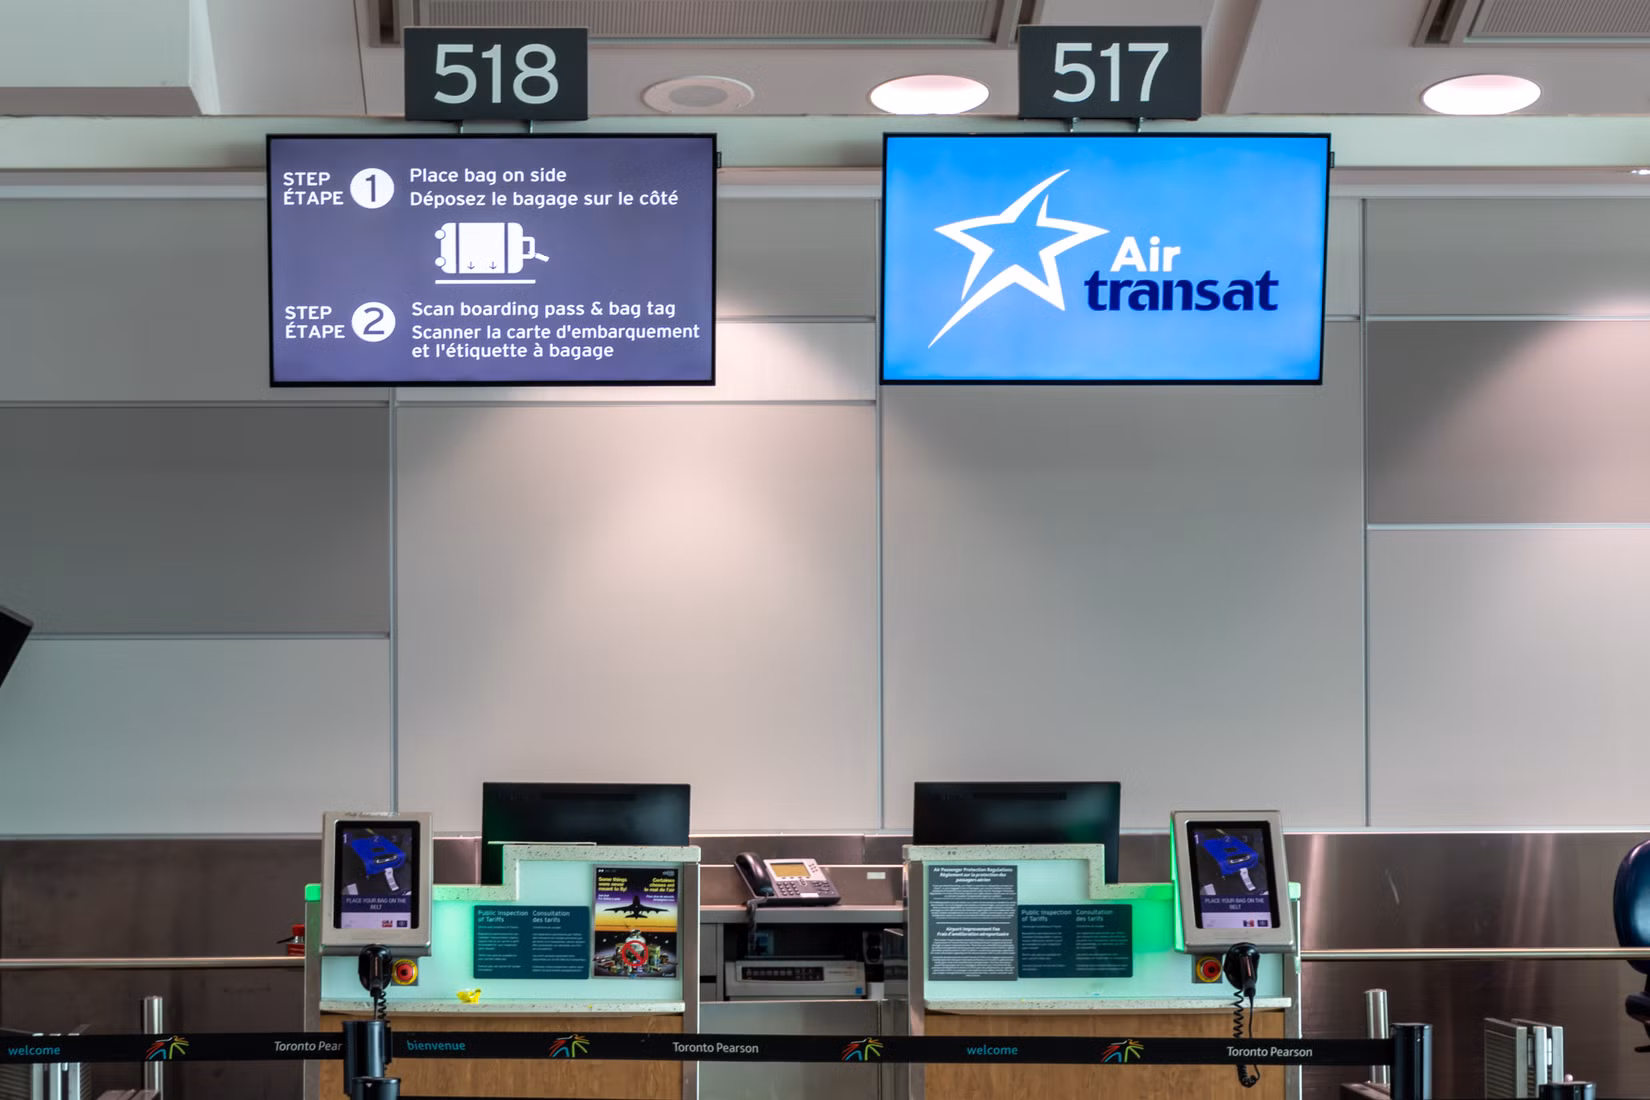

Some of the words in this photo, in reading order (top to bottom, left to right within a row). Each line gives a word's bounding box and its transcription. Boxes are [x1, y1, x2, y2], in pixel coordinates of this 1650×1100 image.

[434, 44, 558, 104] 518
[1053, 43, 1168, 102] 517
[283, 172, 330, 186] STEP
[411, 168, 458, 182] Place
[465, 168, 496, 185] bag
[503, 171, 524, 182] on
[531, 168, 566, 182] side
[284, 188, 343, 205] ÉTAPE
[366, 175, 378, 202] 1
[411, 191, 485, 208] Déposez
[492, 192, 507, 205] le
[513, 192, 578, 208] bagage
[584, 194, 612, 205] sur
[619, 192, 633, 205] le
[640, 190, 678, 205] côté
[1110, 236, 1180, 272] Air
[1084, 269, 1279, 311] transat
[285, 306, 332, 319] STEP
[412, 302, 454, 316] Scan
[461, 302, 538, 319] boarding
[545, 305, 584, 318] pass
[591, 301, 603, 315] &
[609, 302, 640, 318] bag
[647, 301, 675, 318] tag
[363, 308, 385, 335] 2
[286, 322, 345, 338] ÉTAPE
[413, 325, 481, 339] Scanner
[487, 325, 501, 339] la
[507, 325, 551, 339] carte
[557, 325, 700, 341] d'embarquement
[412, 344, 429, 357] et
[436, 343, 527, 360] l'étiquette
[533, 343, 543, 357] à
[550, 343, 613, 360] bagage
[343, 834, 348, 844] 1
[1194, 835, 1199, 845] 1
[8, 1045, 60, 1055] welcome
[274, 1040, 315, 1052] Toronto
[319, 1040, 343, 1052] Pear
[407, 1040, 465, 1050] bienvenue
[673, 1042, 714, 1052] Toronto
[717, 1043, 758, 1053] Pearson
[967, 1045, 1018, 1055] welcome
[1227, 1047, 1268, 1056] Toronto
[1271, 1047, 1312, 1056] Pearson
